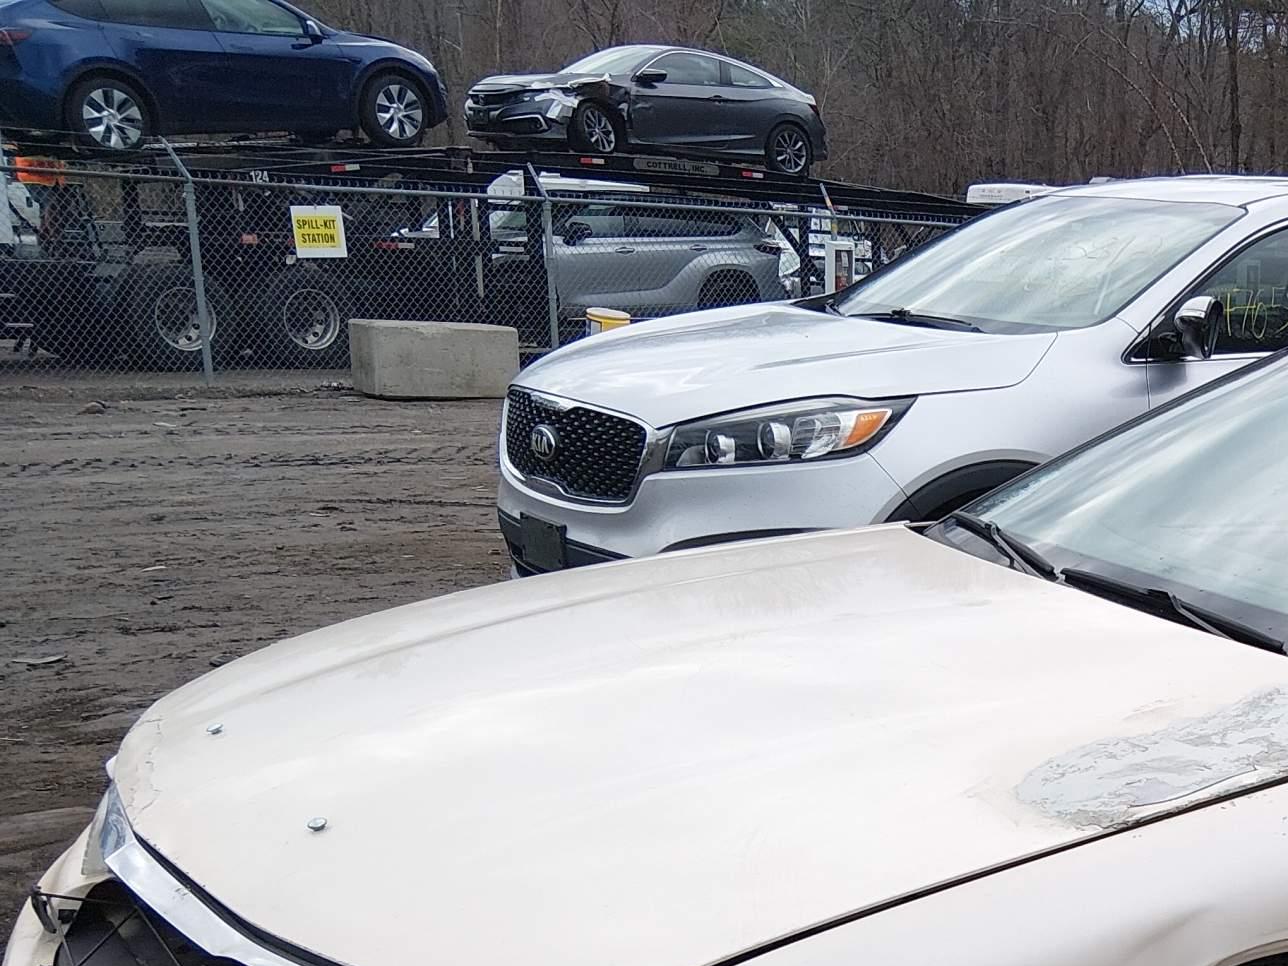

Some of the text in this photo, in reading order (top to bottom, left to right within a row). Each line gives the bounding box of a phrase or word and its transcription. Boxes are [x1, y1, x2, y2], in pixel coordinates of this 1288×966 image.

[250, 170, 270, 184] 124
[296, 219, 337, 231] SPILL-KIT
[301, 232, 337, 244] STATION
